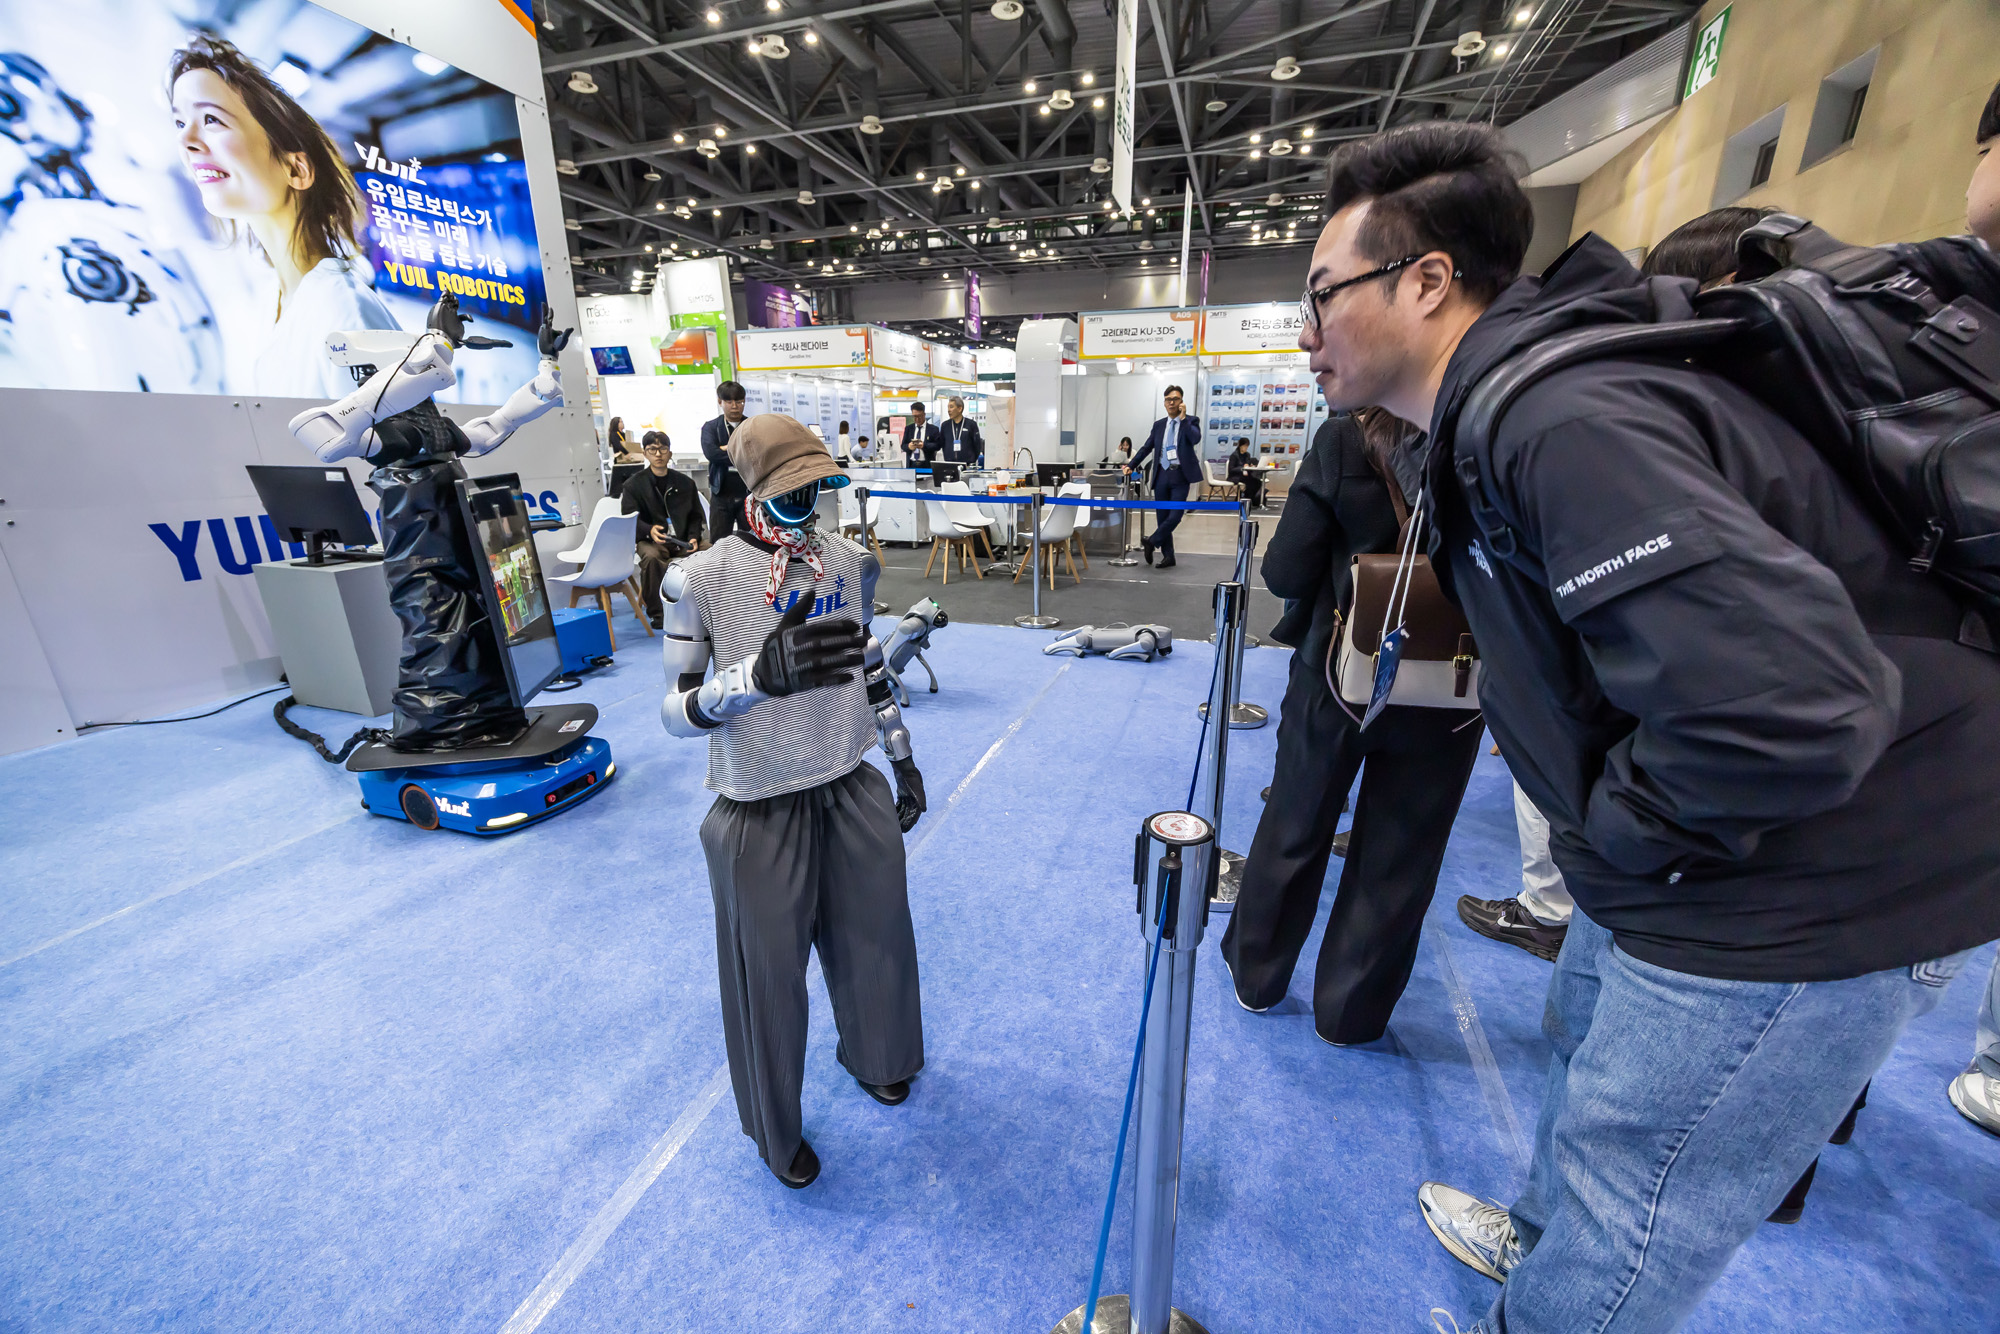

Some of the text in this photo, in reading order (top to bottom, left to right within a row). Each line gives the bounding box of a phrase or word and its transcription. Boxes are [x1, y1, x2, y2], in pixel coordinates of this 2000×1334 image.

[366, 178, 493, 232] 유일로보틱스가
[372, 204, 470, 248] 꿈꾸는 미래
[378, 231, 508, 278] 사람을 돕는 기술
[383, 261, 526, 306] YUIL ROBOTICS
[687, 294, 715, 303] SIMTOS
[1101, 326, 1176, 338] 고려대학교 KU-3DS
[1176, 311, 1191, 319] A05
[771, 341, 829, 352] 주식회사 젠다이브
[1556, 533, 1672, 598] THE NORTH FACE
